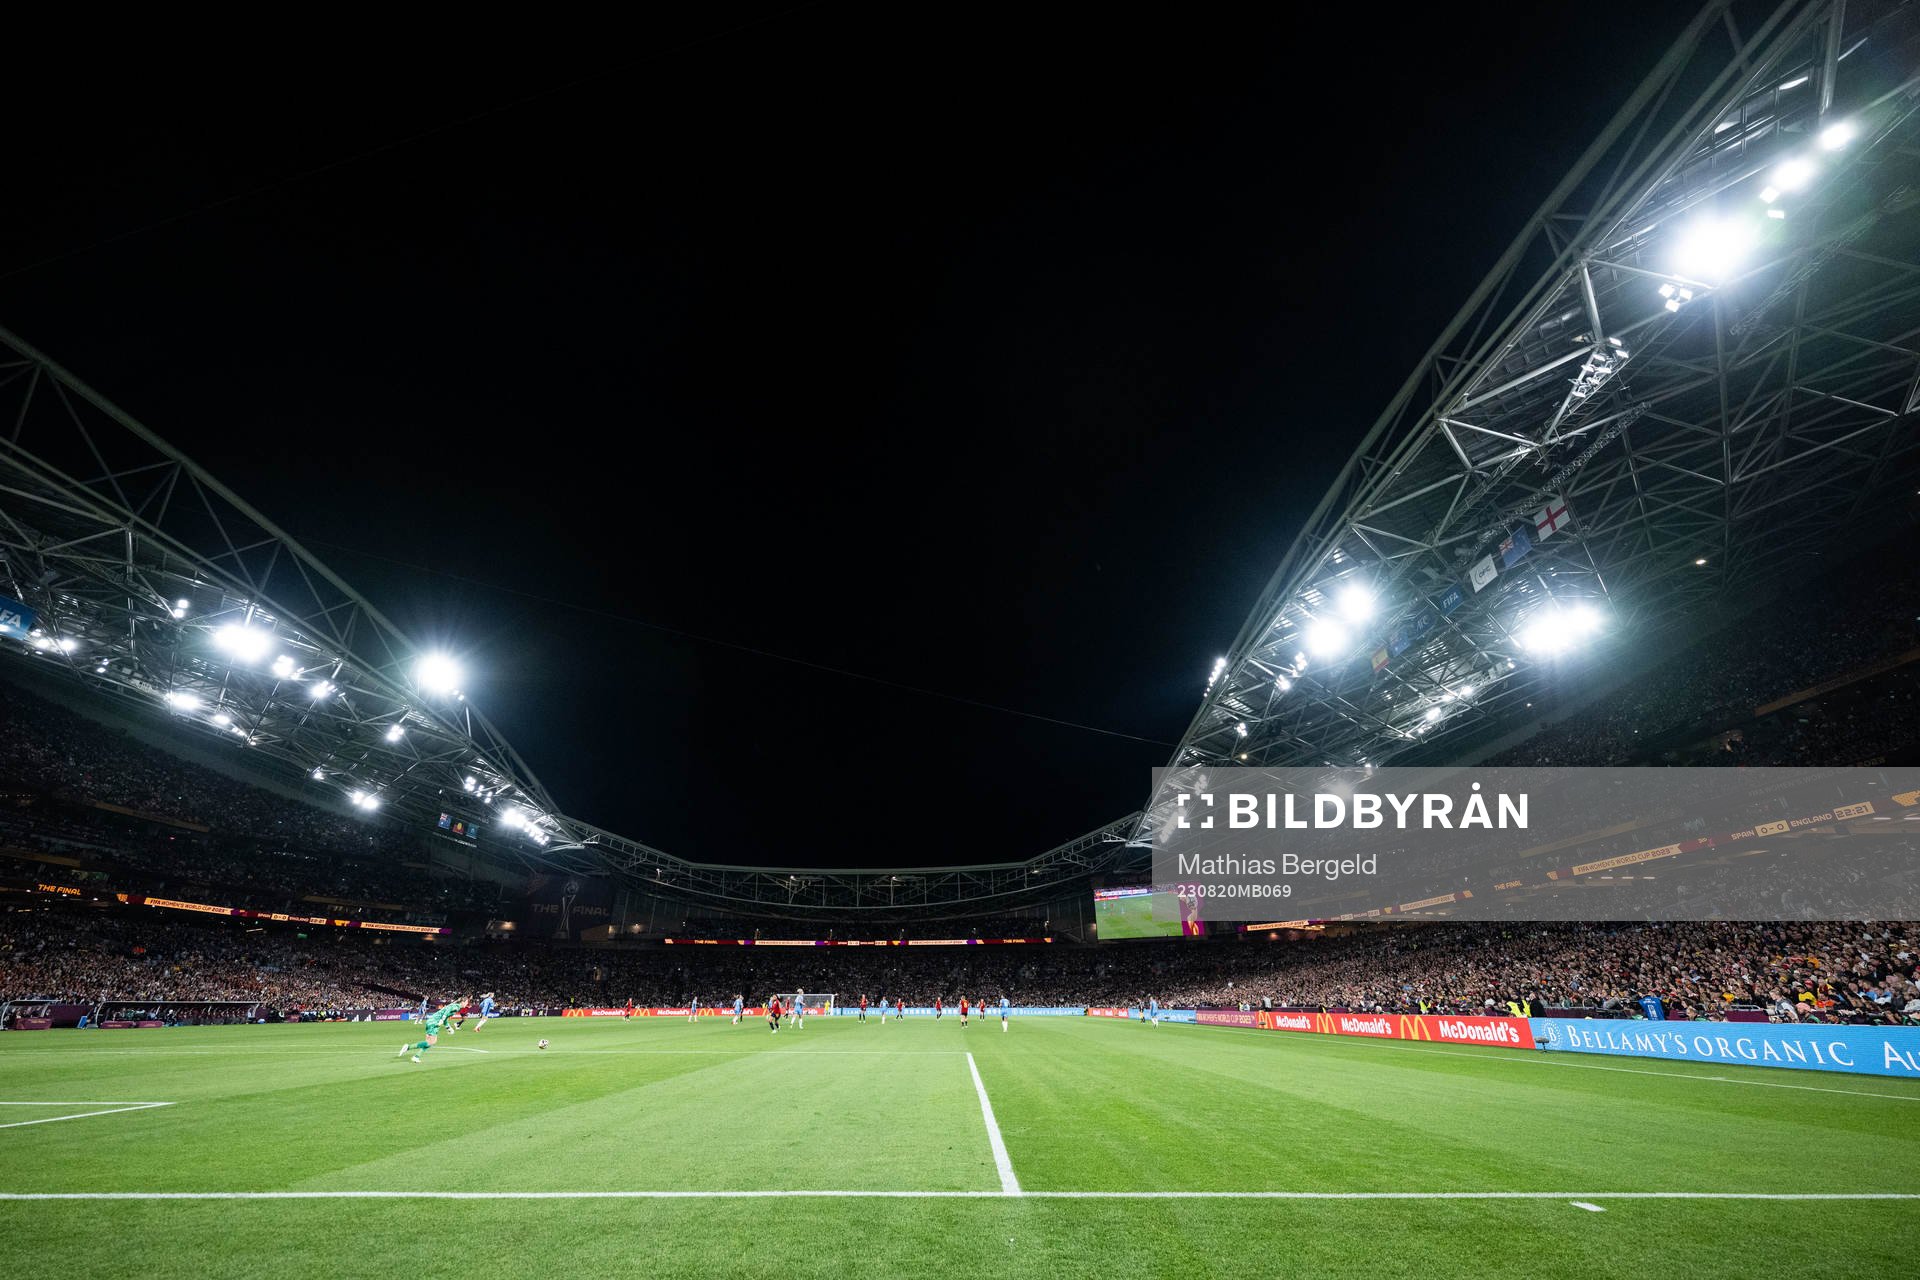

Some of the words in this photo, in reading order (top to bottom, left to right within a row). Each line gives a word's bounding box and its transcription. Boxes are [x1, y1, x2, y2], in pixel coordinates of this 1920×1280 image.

[1442, 592, 1459, 608] FIFA
[1730, 830, 1755, 840] SPAIN
[1790, 813, 1832, 828] ENGLAND
[1836, 804, 1869, 819] 22:21
[1589, 860, 1616, 870] WOMEN'S
[1616, 856, 1636, 865] WORLD
[38, 884, 56, 892] THE
[56, 886, 81, 896] FINAL
[1506, 880, 1522, 888] FINAL
[532, 904, 560, 914] THE
[572, 905, 609, 916] FINAL
[1276, 1015, 1311, 1029] McDonald's
[1341, 1017, 1392, 1034] McDonald's
[1438, 1020, 1520, 1043] McDonald's
[1566, 1024, 1688, 1054] BELLAMY'S
[1693, 1036, 1854, 1066] ORGANIC
